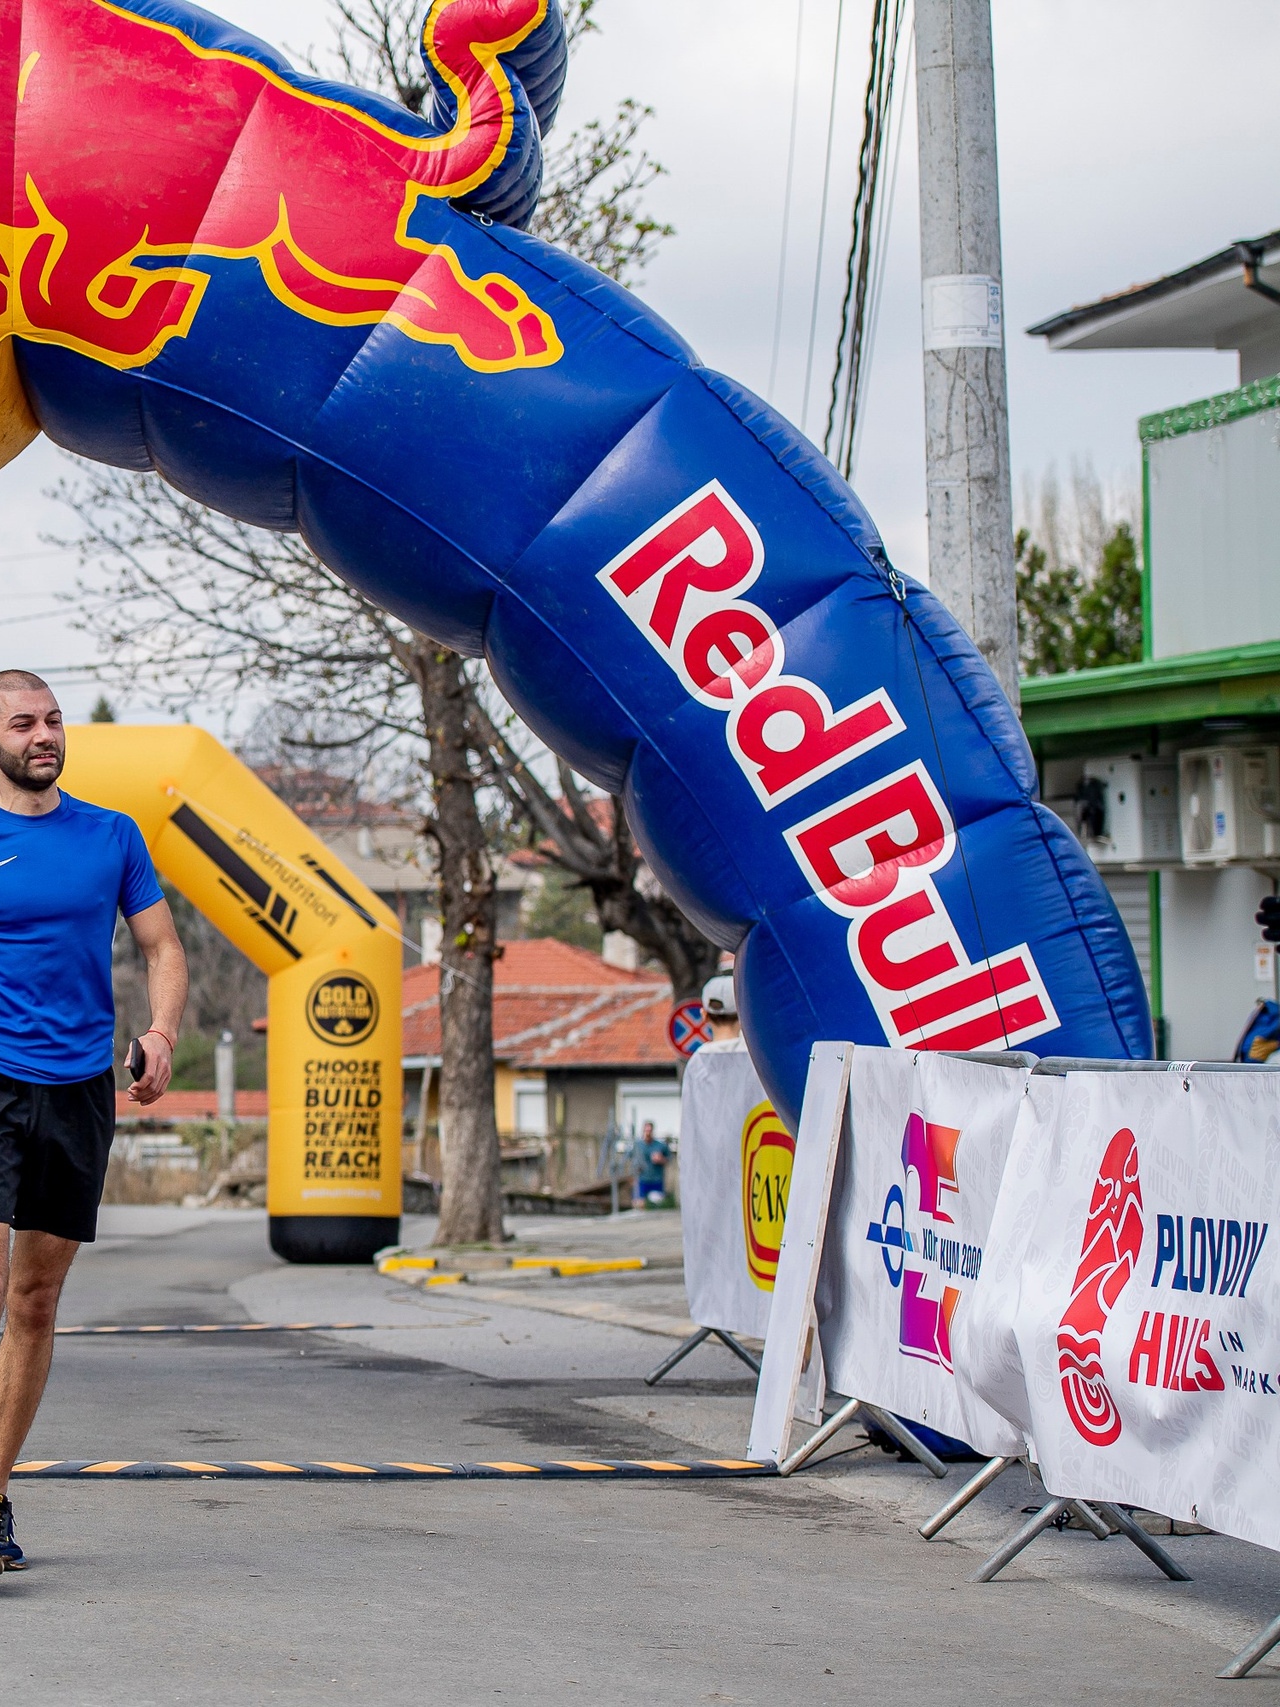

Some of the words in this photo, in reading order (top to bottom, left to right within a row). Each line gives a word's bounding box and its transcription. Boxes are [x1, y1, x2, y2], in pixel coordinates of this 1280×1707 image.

[606, 487, 895, 800] Red
[793, 768, 1051, 1051] Bull
[318, 985, 369, 1005] GOLD
[304, 1060, 382, 1075] CHOOSE
[304, 1088, 383, 1108] BUILD
[304, 1122, 381, 1137] DEFINE
[304, 1150, 382, 1168] REACH
[940, 1237, 960, 1279] КЦМ
[961, 1243, 982, 1281] 2000
[1150, 1213, 1269, 1299] PLOVDIV
[1128, 1311, 1225, 1391] HILLS
[1219, 1331, 1244, 1352] IN
[1231, 1364, 1280, 1395] MARK
